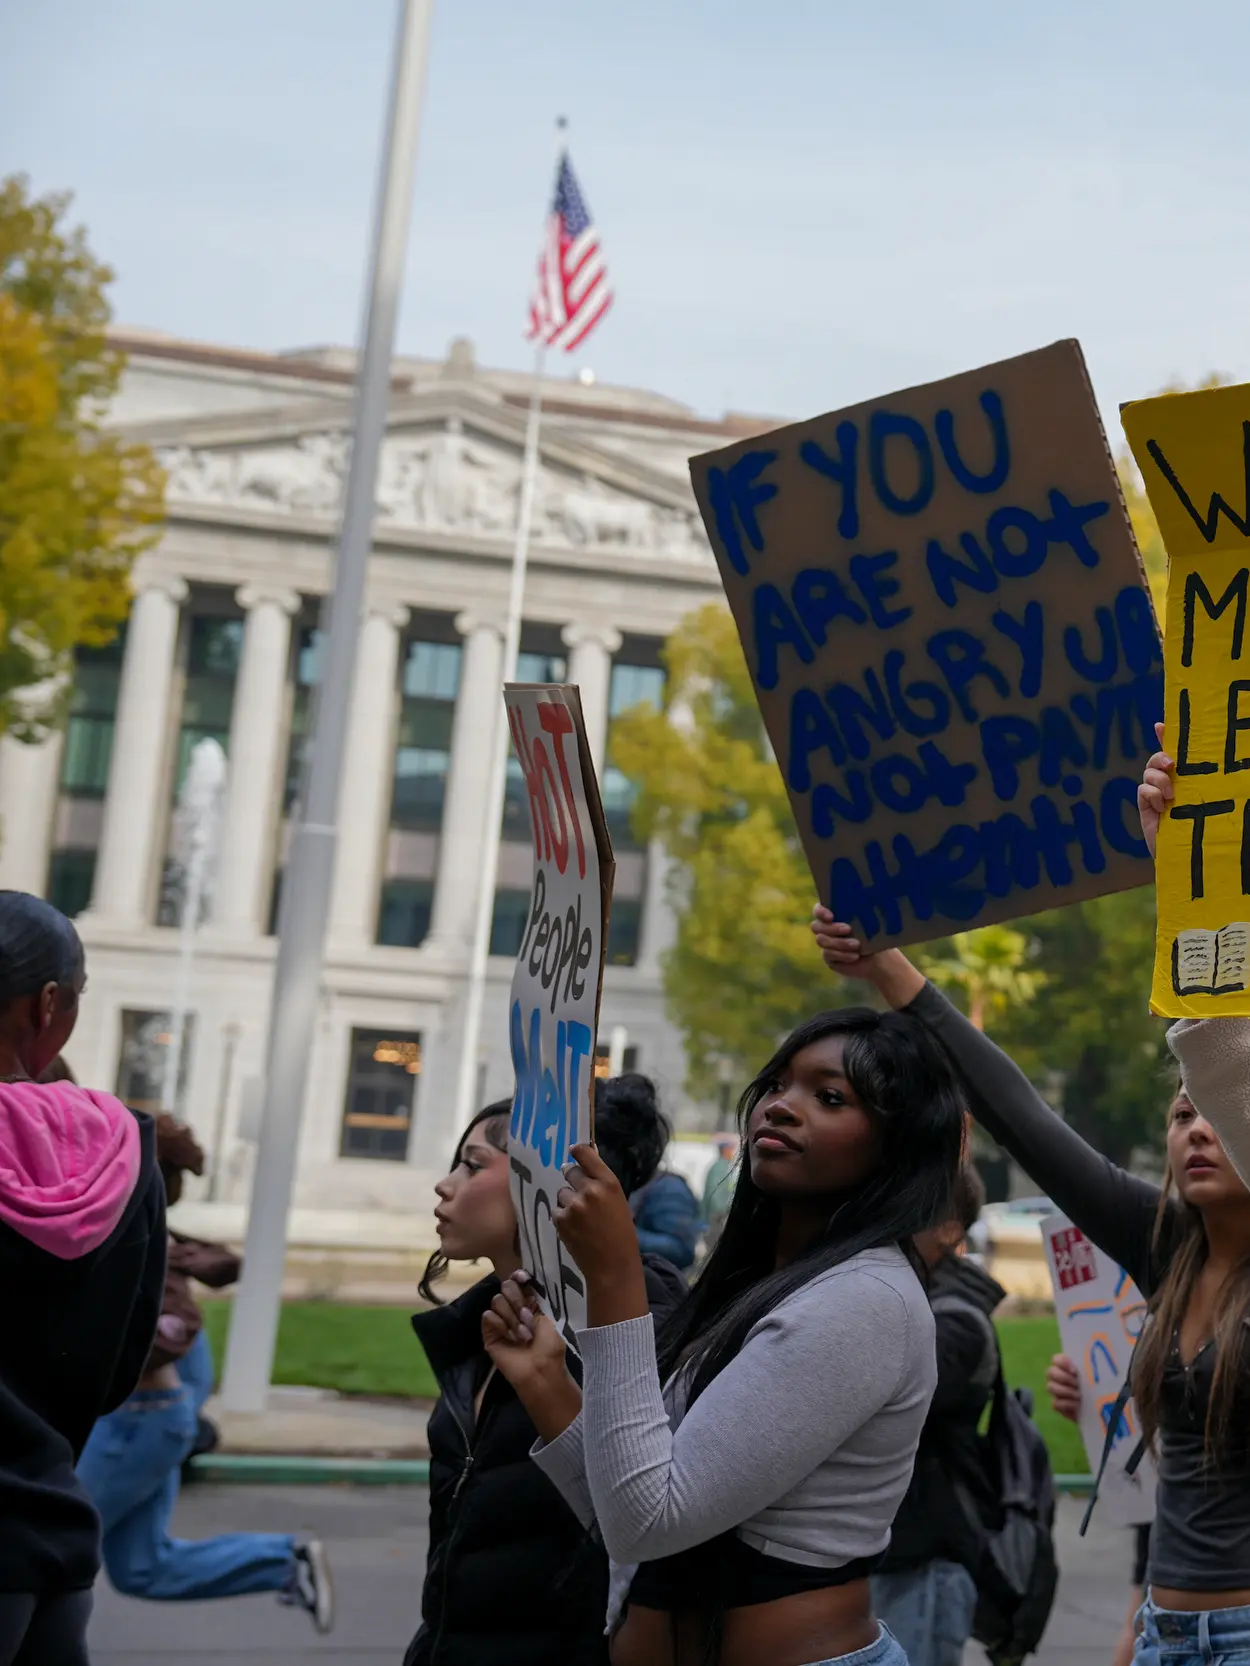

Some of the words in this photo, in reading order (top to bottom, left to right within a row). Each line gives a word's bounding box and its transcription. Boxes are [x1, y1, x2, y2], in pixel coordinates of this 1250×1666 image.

[708, 449, 780, 577] IF
[798, 389, 1011, 542] YOU
[752, 549, 913, 691] ARE
[788, 600, 1047, 795] ANGRY
[508, 702, 587, 881] HOT
[520, 868, 593, 1015] People
